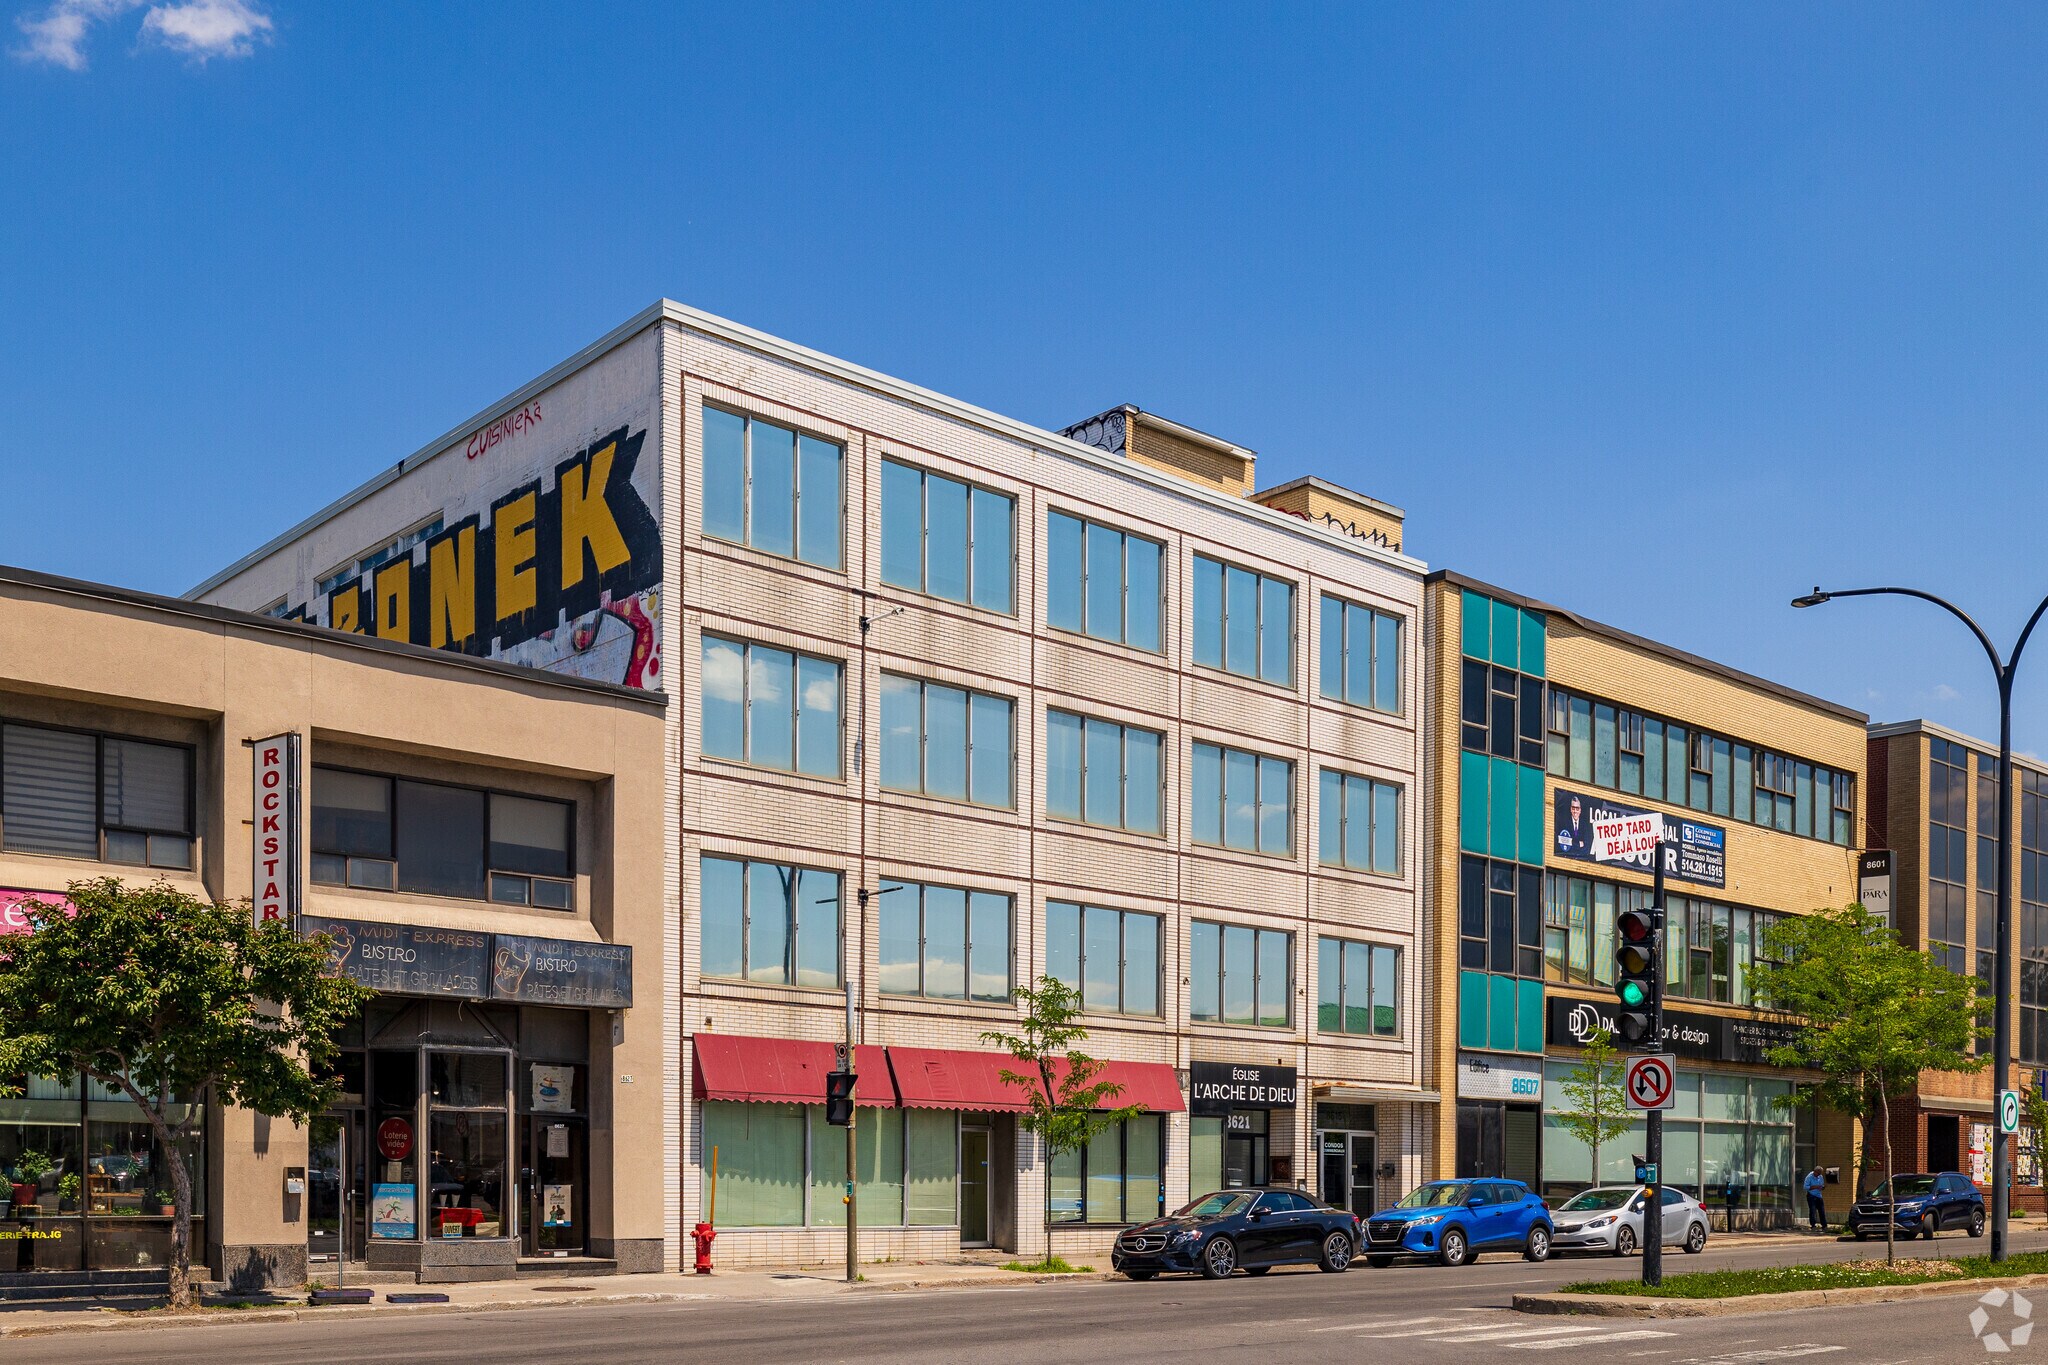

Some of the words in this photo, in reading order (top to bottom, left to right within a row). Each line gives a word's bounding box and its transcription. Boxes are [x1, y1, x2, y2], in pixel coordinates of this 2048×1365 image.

[262, 747, 280, 920] ROCKSTAR
[1597, 822, 1624, 839] TROP
[1626, 819, 1652, 835] TARD
[1607, 837, 1633, 856] DÉJÀ
[1695, 839, 1721, 849] COMMERCIAL
[1682, 850, 1705, 861] Tommaso
[1706, 855, 1722, 865] Roselli
[1866, 860, 1885, 869] 8601
[1682, 859, 1722, 877] 514.281.1515
[362, 943, 416, 963] BISTRO
[536, 957, 577, 973] BISTRO
[1681, 1026, 1709, 1045] design
[1232, 1067, 1260, 1081] ÉGLISE
[1194, 1083, 1246, 1101] L'ARCHE
[1249, 1086, 1265, 1101] DE
[1268, 1087, 1296, 1103] DIEU
[1512, 1077, 1539, 1095] 8607
[384, 1130, 408, 1140] Loterie
[387, 1140, 405, 1149] vidéo
[444, 1225, 460, 1234] OUVERT
